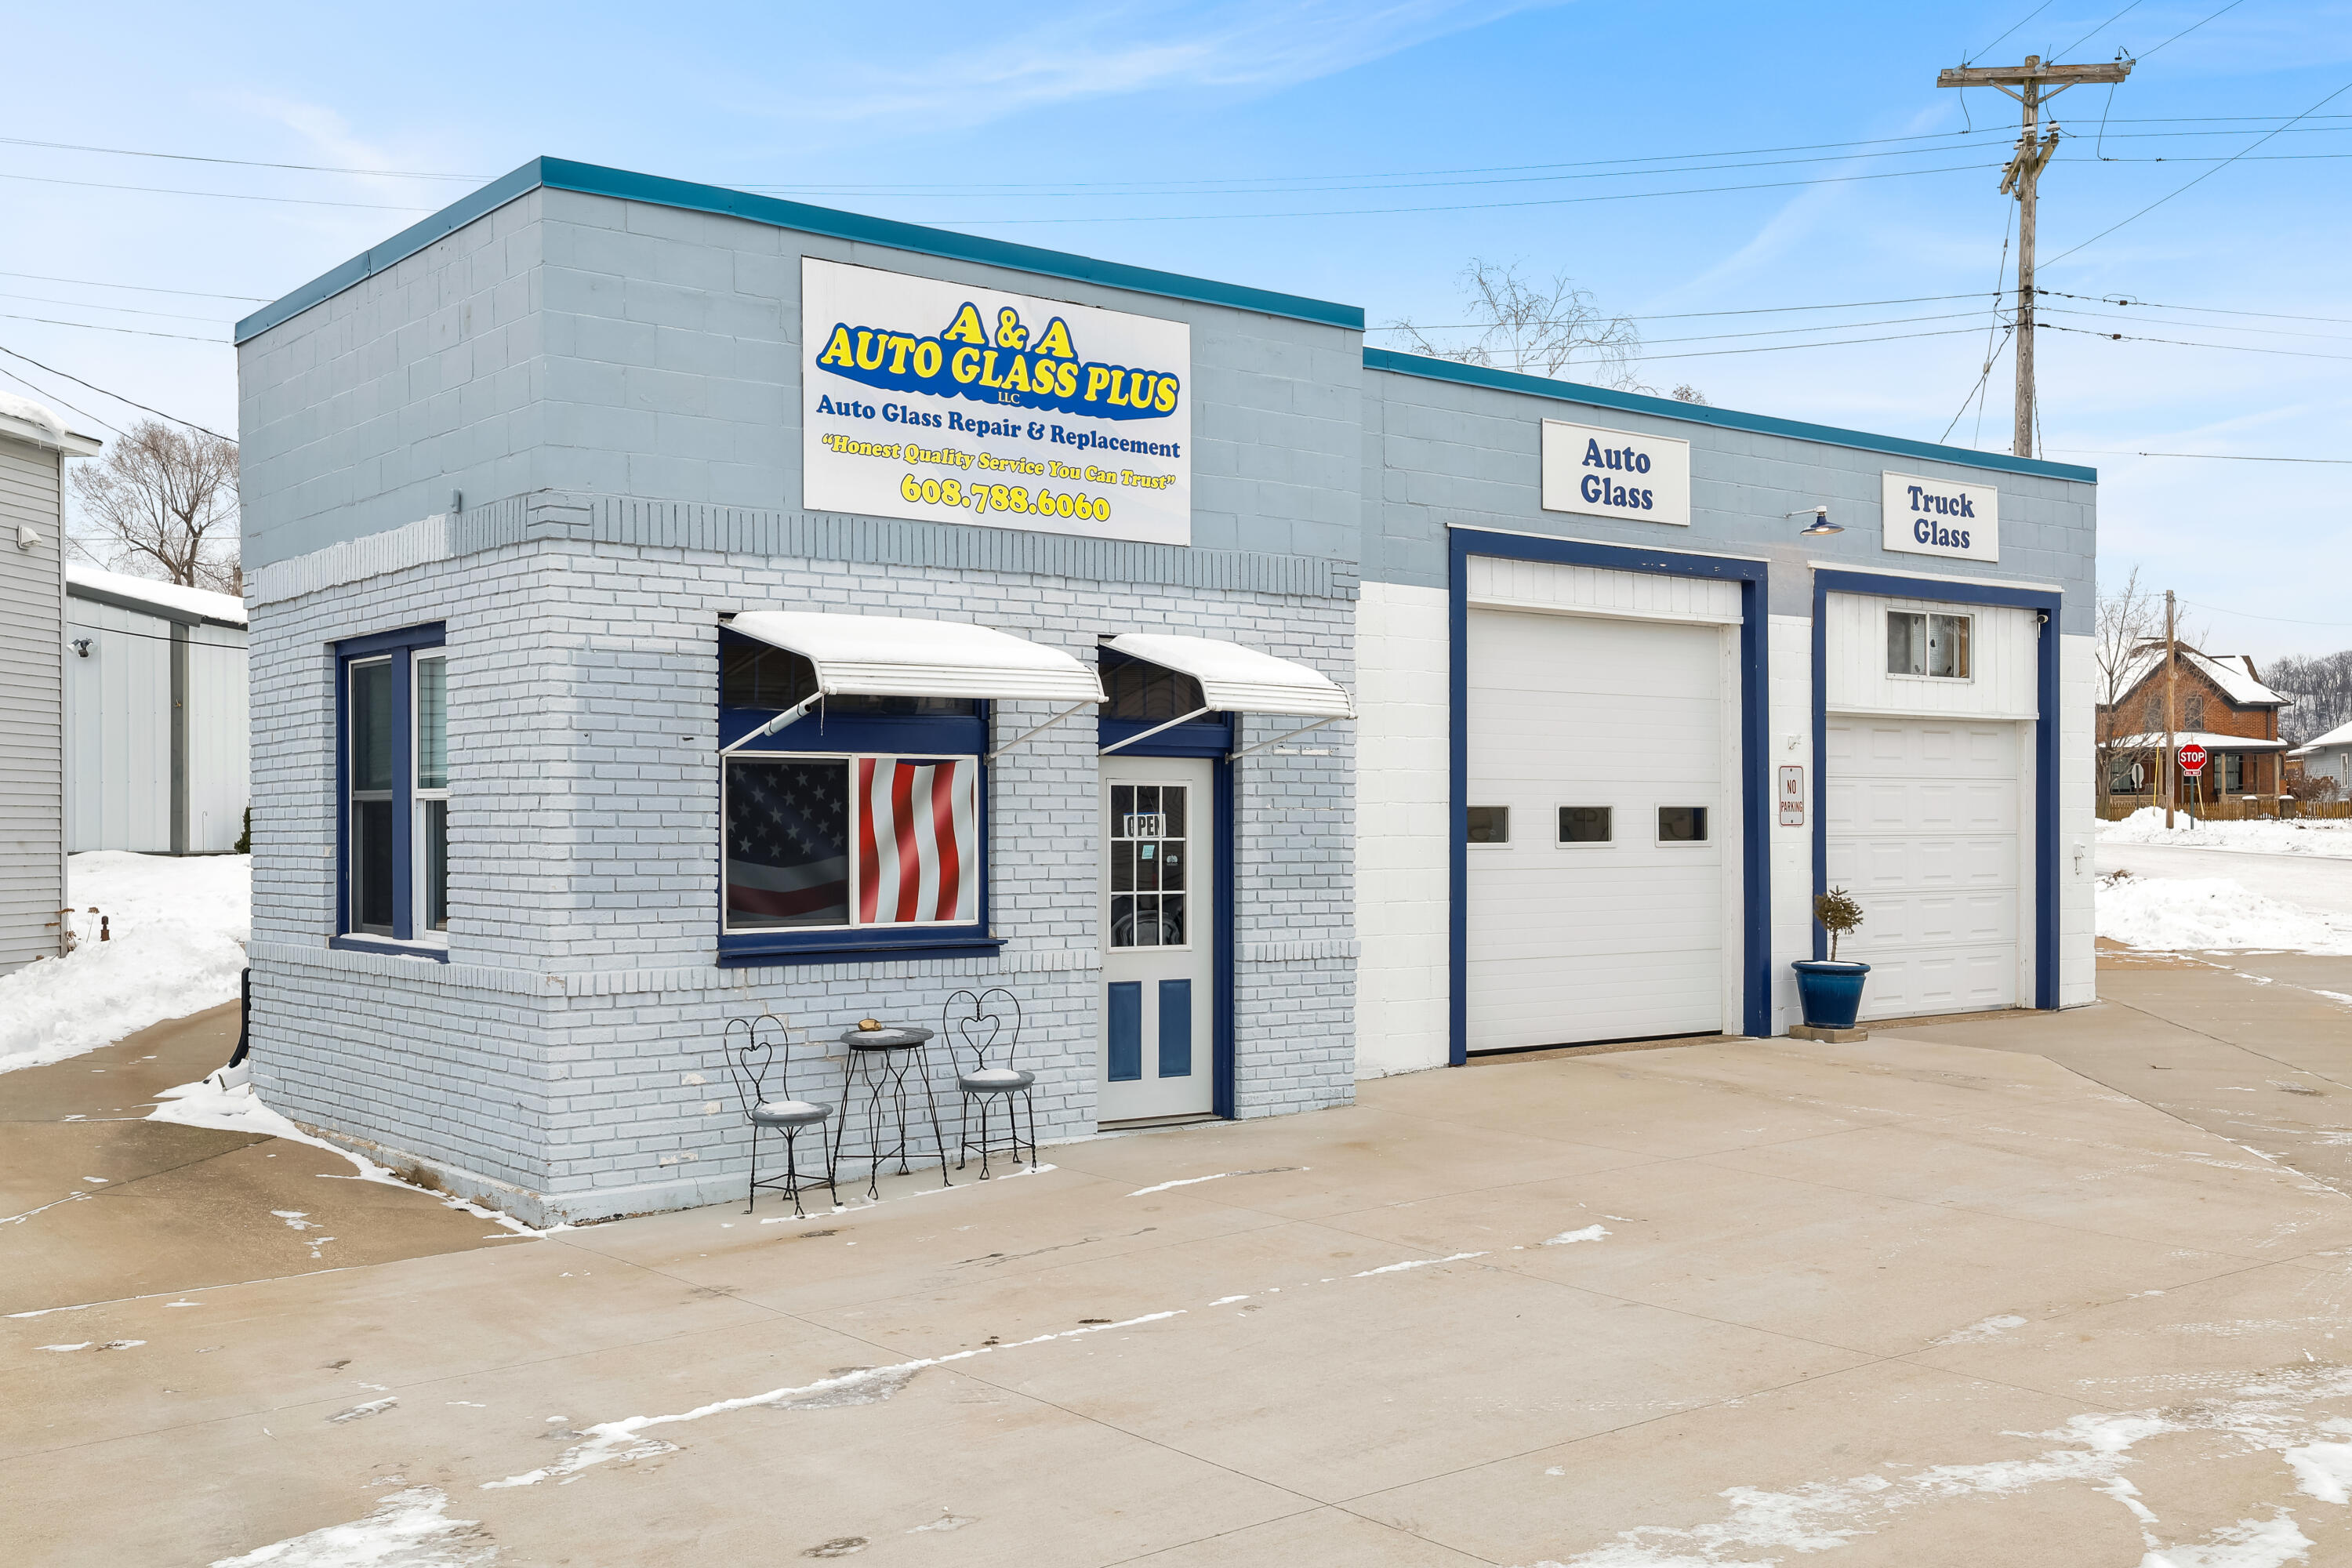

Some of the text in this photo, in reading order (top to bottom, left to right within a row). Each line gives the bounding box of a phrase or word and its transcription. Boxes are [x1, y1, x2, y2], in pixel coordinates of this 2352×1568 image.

[943, 305, 1074, 358] A & A
[820, 327, 1178, 412] AUTO GLASS PLUS
[997, 391, 1021, 405] LLC
[816, 394, 1181, 458] Auto Glass Repair & Replacement
[822, 434, 1176, 490] “Honest Quality Service You Can Trust”
[1582, 437, 1651, 474] Auto
[901, 474, 1111, 521] 608.788.6060
[1581, 474, 1653, 510] Glass
[1907, 485, 1975, 517] Truck
[1914, 518, 1970, 549] Glass
[2180, 752, 2205, 762] STOP
[1787, 779, 1796, 794] NO
[1780, 801, 1803, 813] PARKING
[1127, 815, 1163, 837] OPEN
